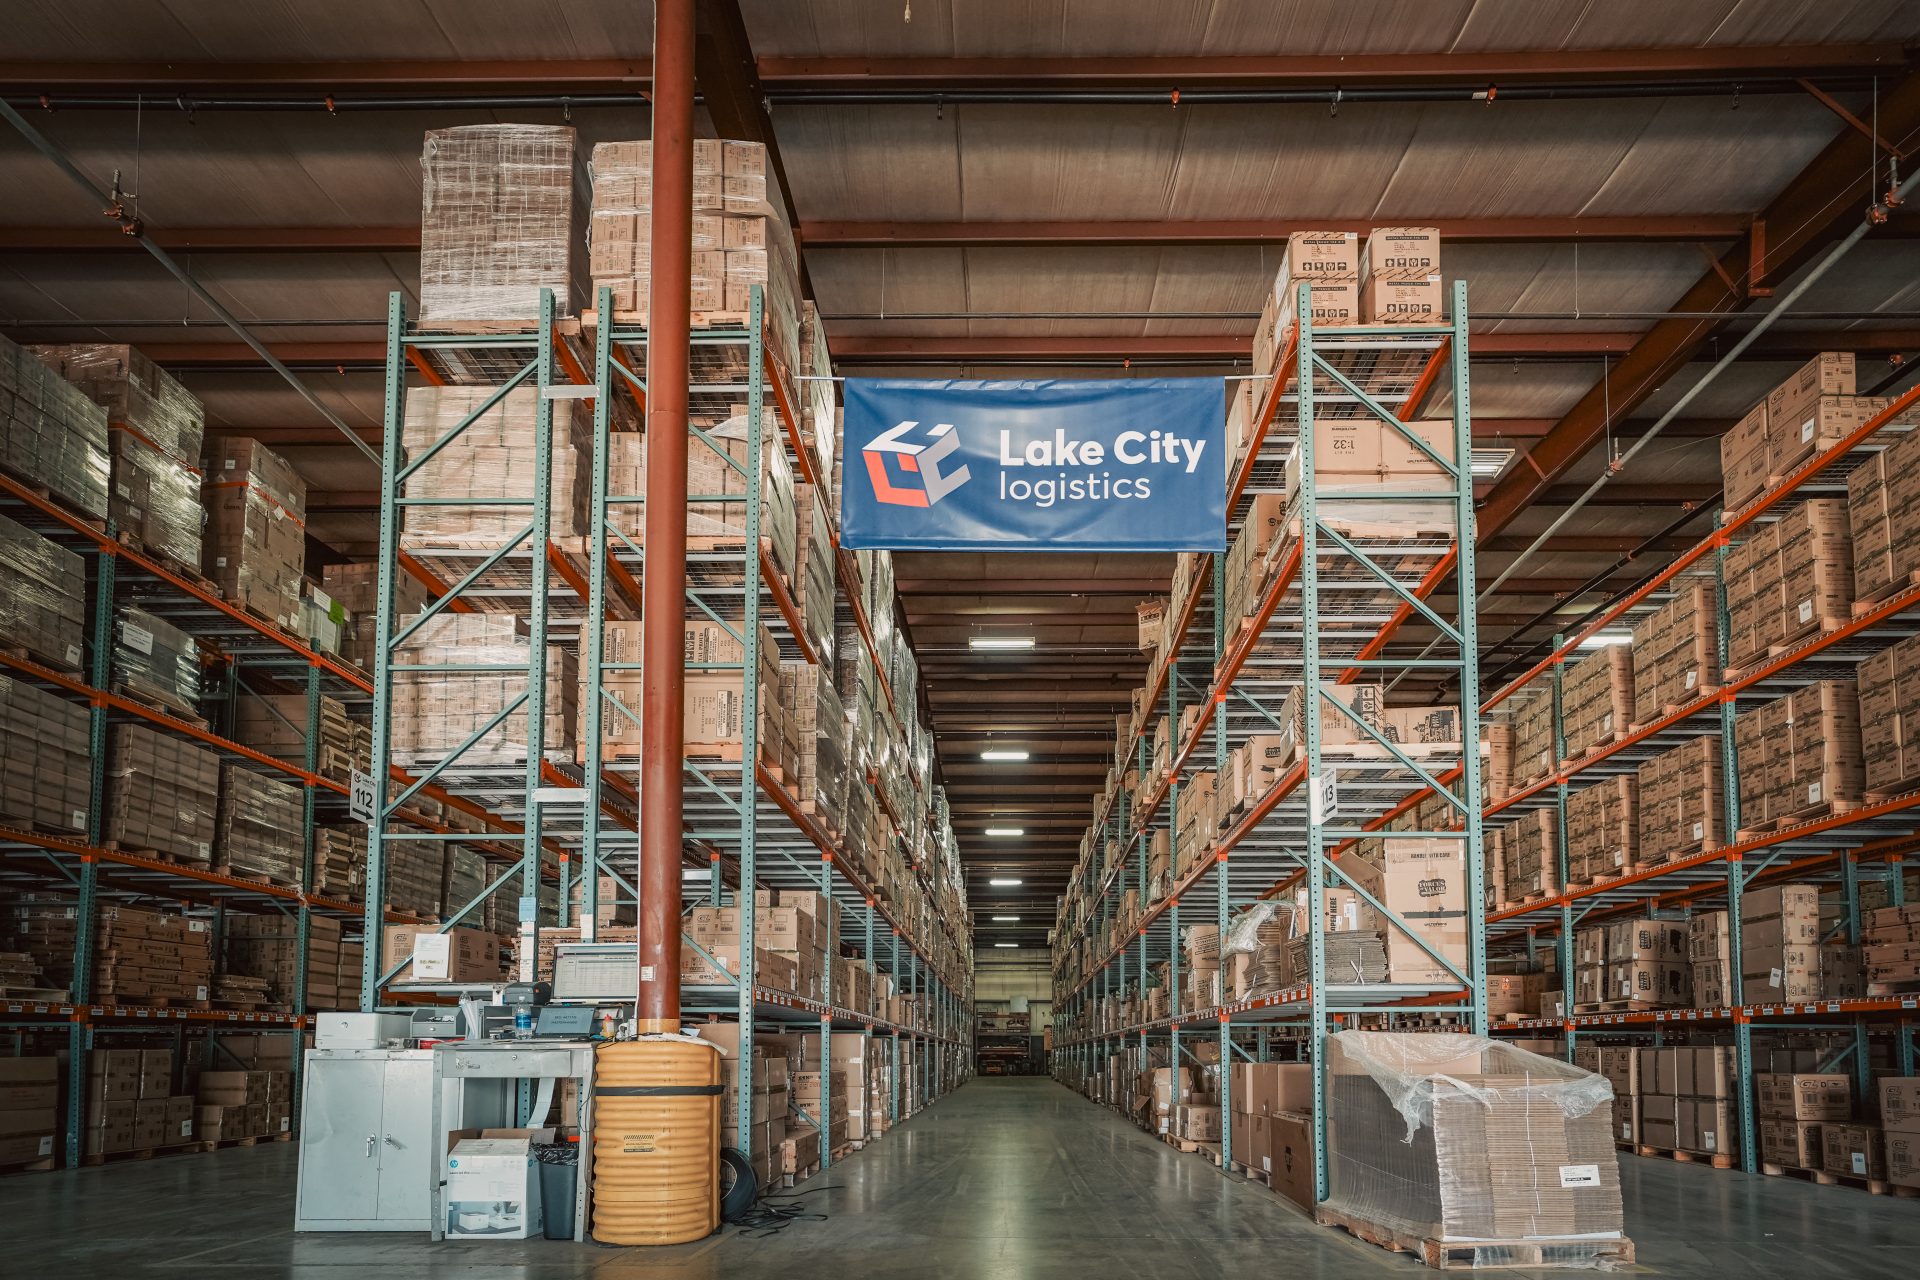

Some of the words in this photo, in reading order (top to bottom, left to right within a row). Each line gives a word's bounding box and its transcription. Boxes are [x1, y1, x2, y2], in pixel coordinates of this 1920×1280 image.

[1000, 428, 1105, 466] Lake
[1113, 430, 1206, 473] City
[1333, 439, 1355, 449] 1:32
[1000, 472, 1151, 507] logistics
[355, 787, 373, 809] 112
[1322, 784, 1334, 806] 113
[1329, 897, 1337, 914] HERE
